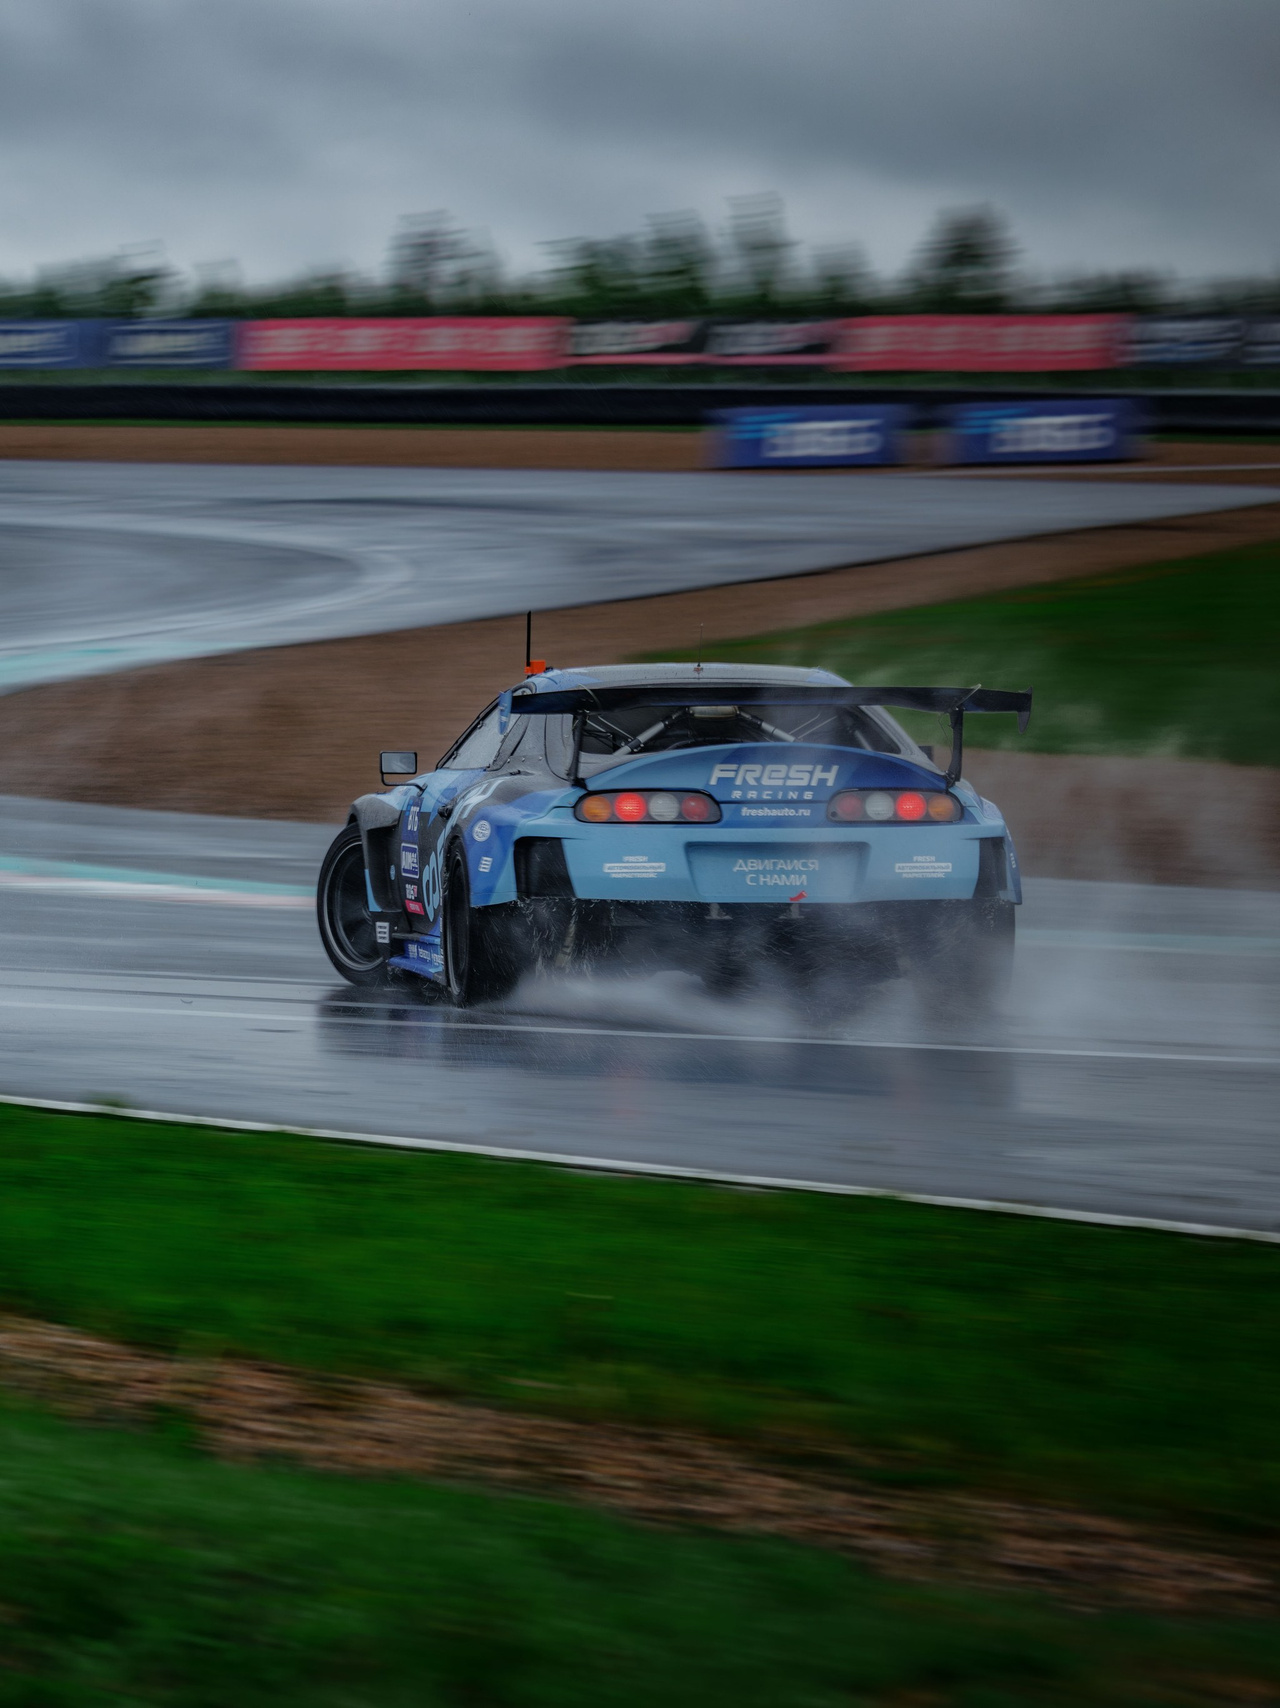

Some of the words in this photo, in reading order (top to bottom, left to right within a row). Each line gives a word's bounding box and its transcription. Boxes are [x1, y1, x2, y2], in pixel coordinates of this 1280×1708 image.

[731, 790, 814, 800] RACING
[741, 807, 811, 817] freshauto.ru
[746, 874, 757, 886] С
[759, 874, 808, 886] НАМИ
